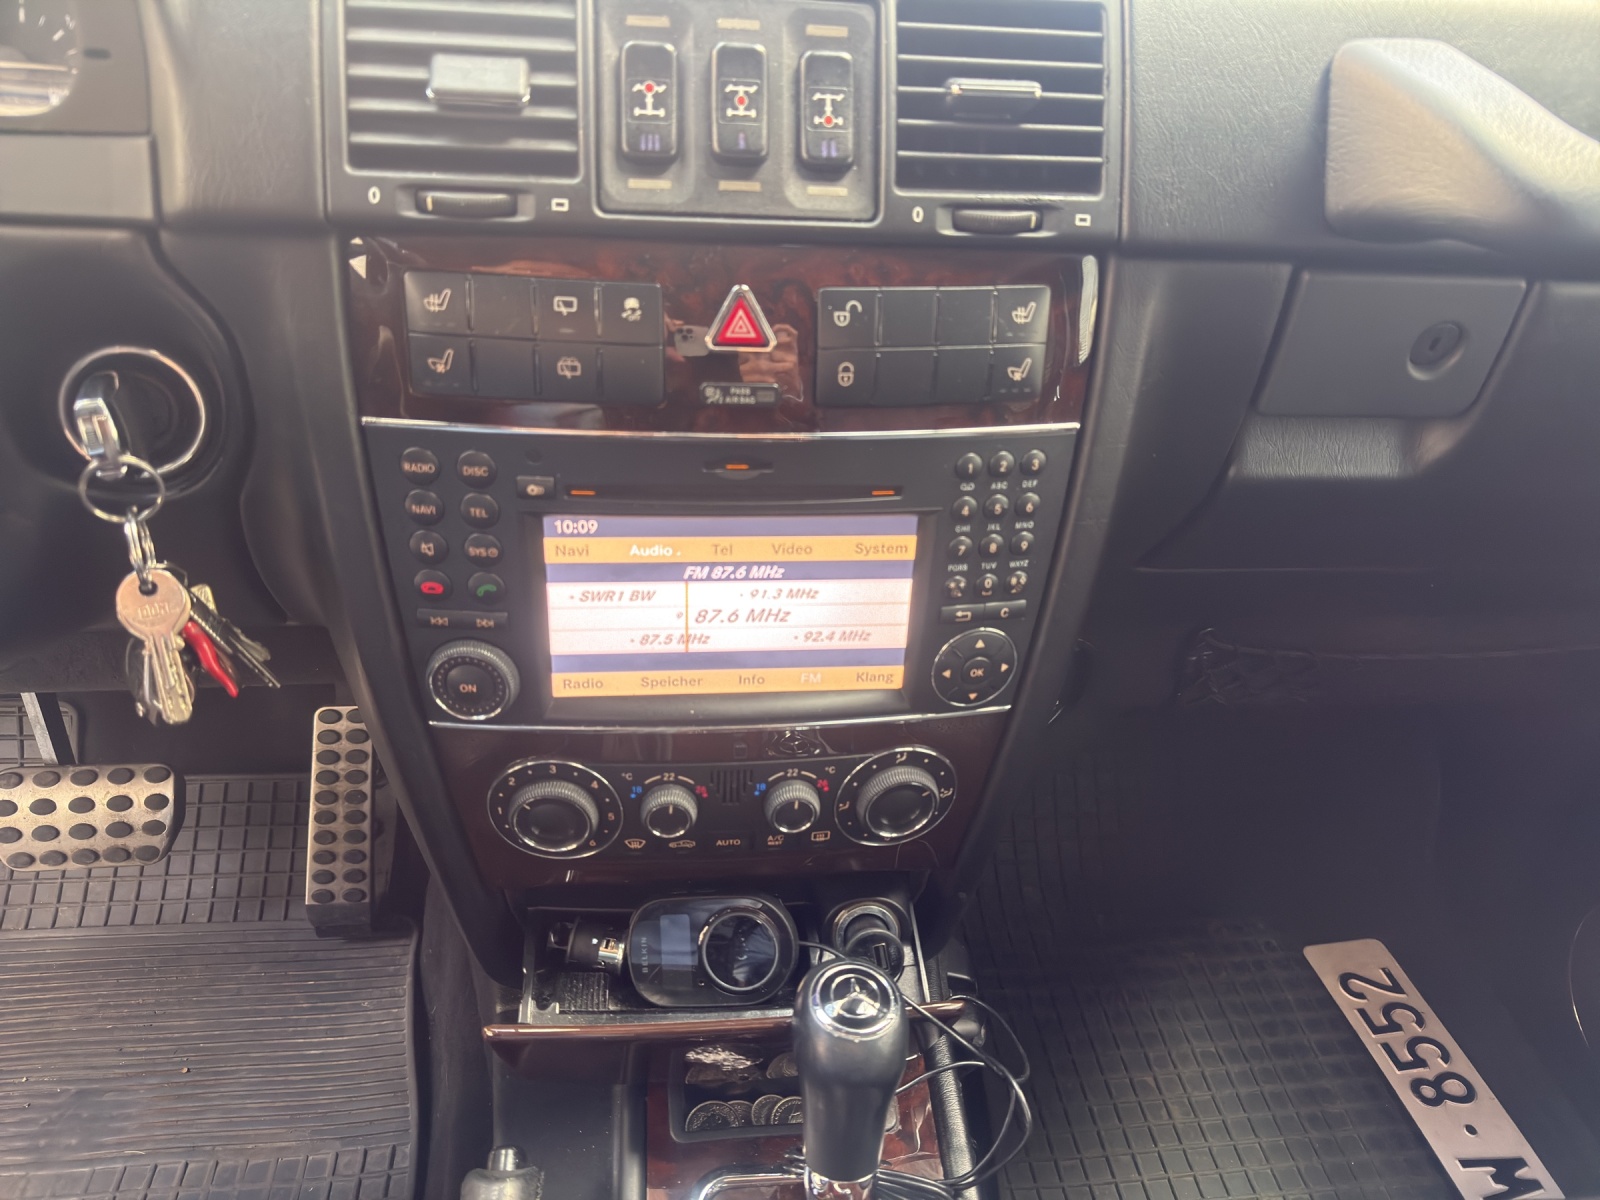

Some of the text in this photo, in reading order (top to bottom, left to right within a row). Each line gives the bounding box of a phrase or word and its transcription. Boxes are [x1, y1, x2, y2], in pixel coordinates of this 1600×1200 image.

[402, 462, 436, 474] RADIO
[968, 463, 974, 474] 1
[999, 461, 1008, 473] 2
[1031, 459, 1040, 471] 3
[463, 466, 489, 477] DISC
[411, 504, 436, 515] NAVI
[470, 507, 489, 518] TEL
[961, 505, 970, 517] 4
[994, 503, 1002, 515] 5
[1025, 502, 1034, 513] 6
[554, 519, 598, 534] 10:09
[555, 543, 908, 557] Navi Audio Tel Video System
[957, 545, 967, 556] 7
[1020, 541, 1029, 551] 9
[683, 565, 786, 580] FM 87.6 MHz
[984, 578, 993, 589] 0
[579, 590, 657, 603] SWR1 BW
[750, 588, 819, 600] 91.3 MHz
[695, 608, 792, 624] 87.6 MHz
[1000, 607, 1010, 618] C
[639, 633, 711, 646] 87.5 MHz
[803, 630, 873, 643] 92.4 MHz
[970, 668, 985, 678] OK
[562, 672, 895, 690] Radio Speicher Info FM Klang
[459, 684, 477, 693] ON
[549, 764, 557, 774] 3
[787, 768, 799, 777] 22
[508, 777, 516, 786] 2
[663, 772, 675, 781] 22
[591, 780, 600, 789] 4
[607, 812, 615, 821] 5
[589, 839, 597, 847] 6
[716, 839, 741, 847] AUTO
[640, 937, 649, 973] BELKIN
[1338, 967, 1478, 1108] 8552
